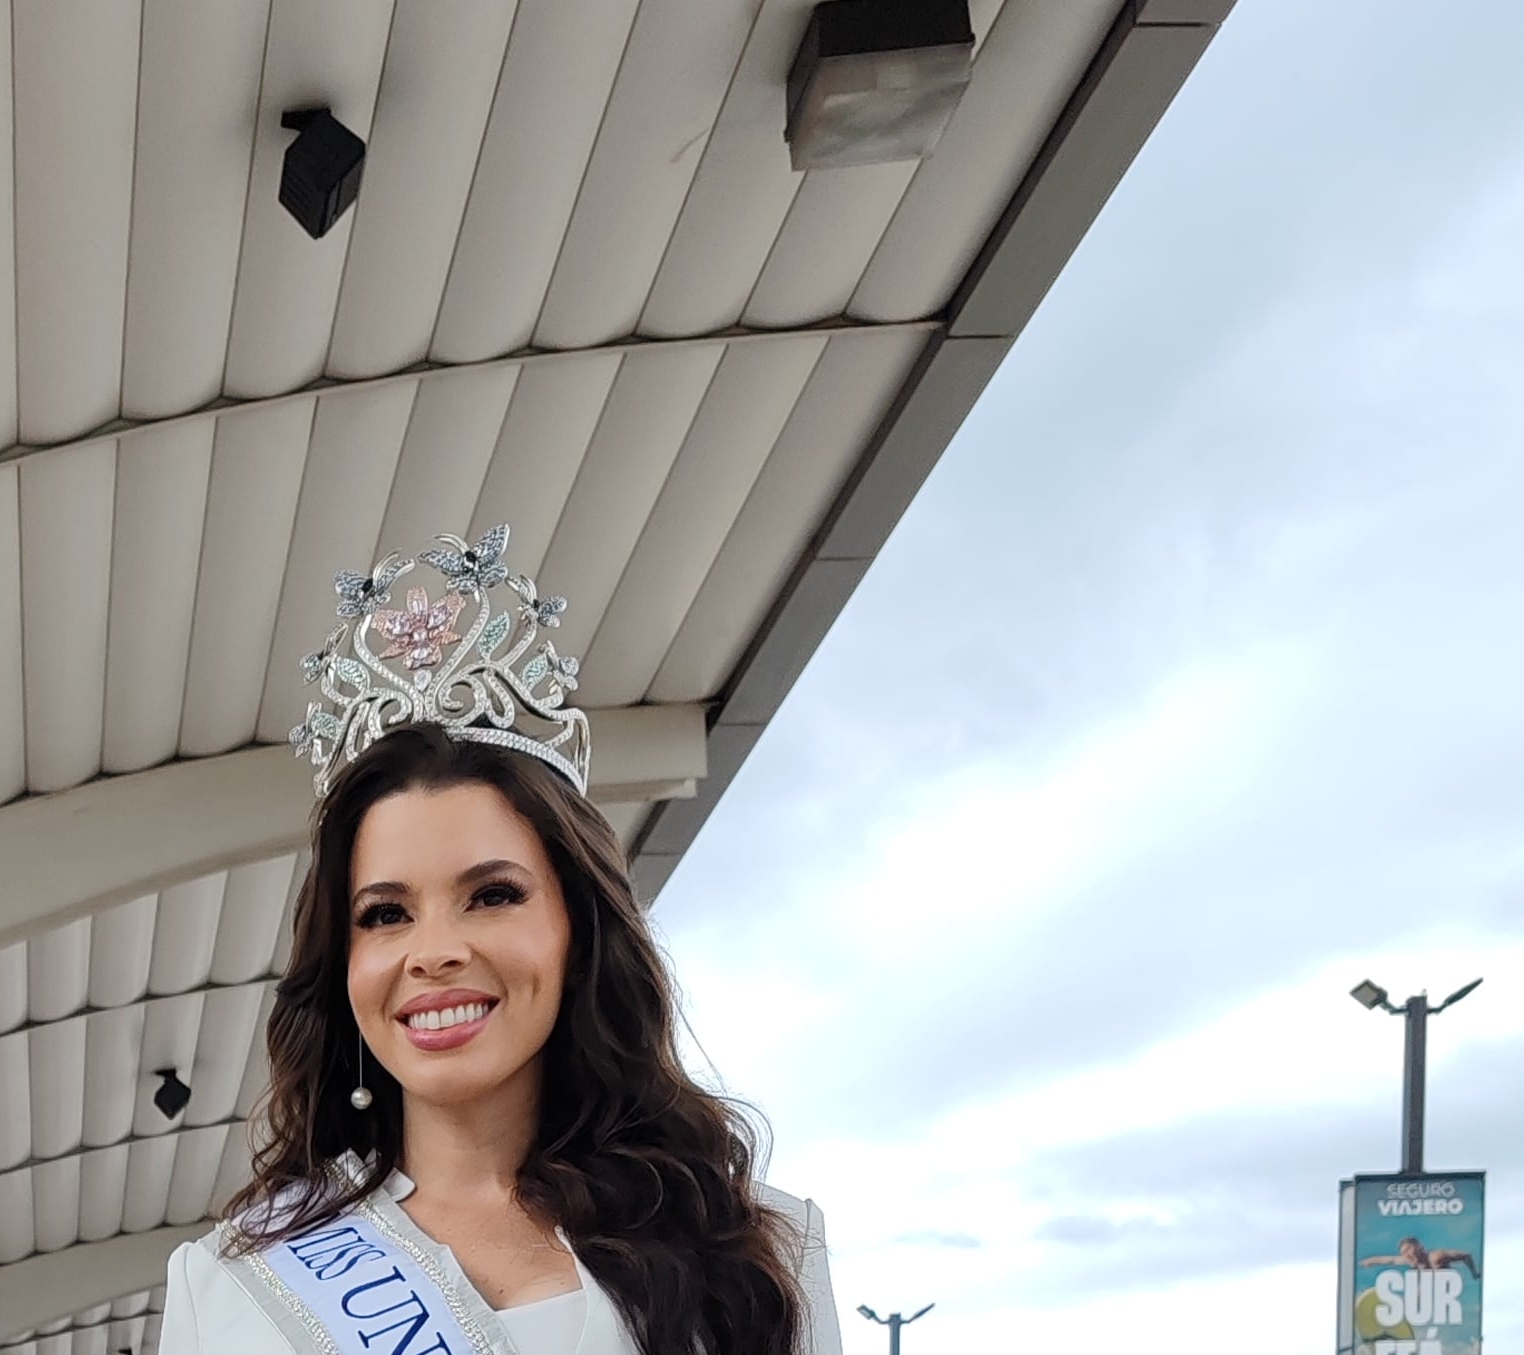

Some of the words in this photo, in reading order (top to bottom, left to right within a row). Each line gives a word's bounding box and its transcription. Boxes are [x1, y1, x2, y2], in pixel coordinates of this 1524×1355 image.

[1386, 1181, 1456, 1199] SEGURO
[1377, 1199, 1464, 1217] VIAJERO
[1375, 1267, 1464, 1327] SUR
